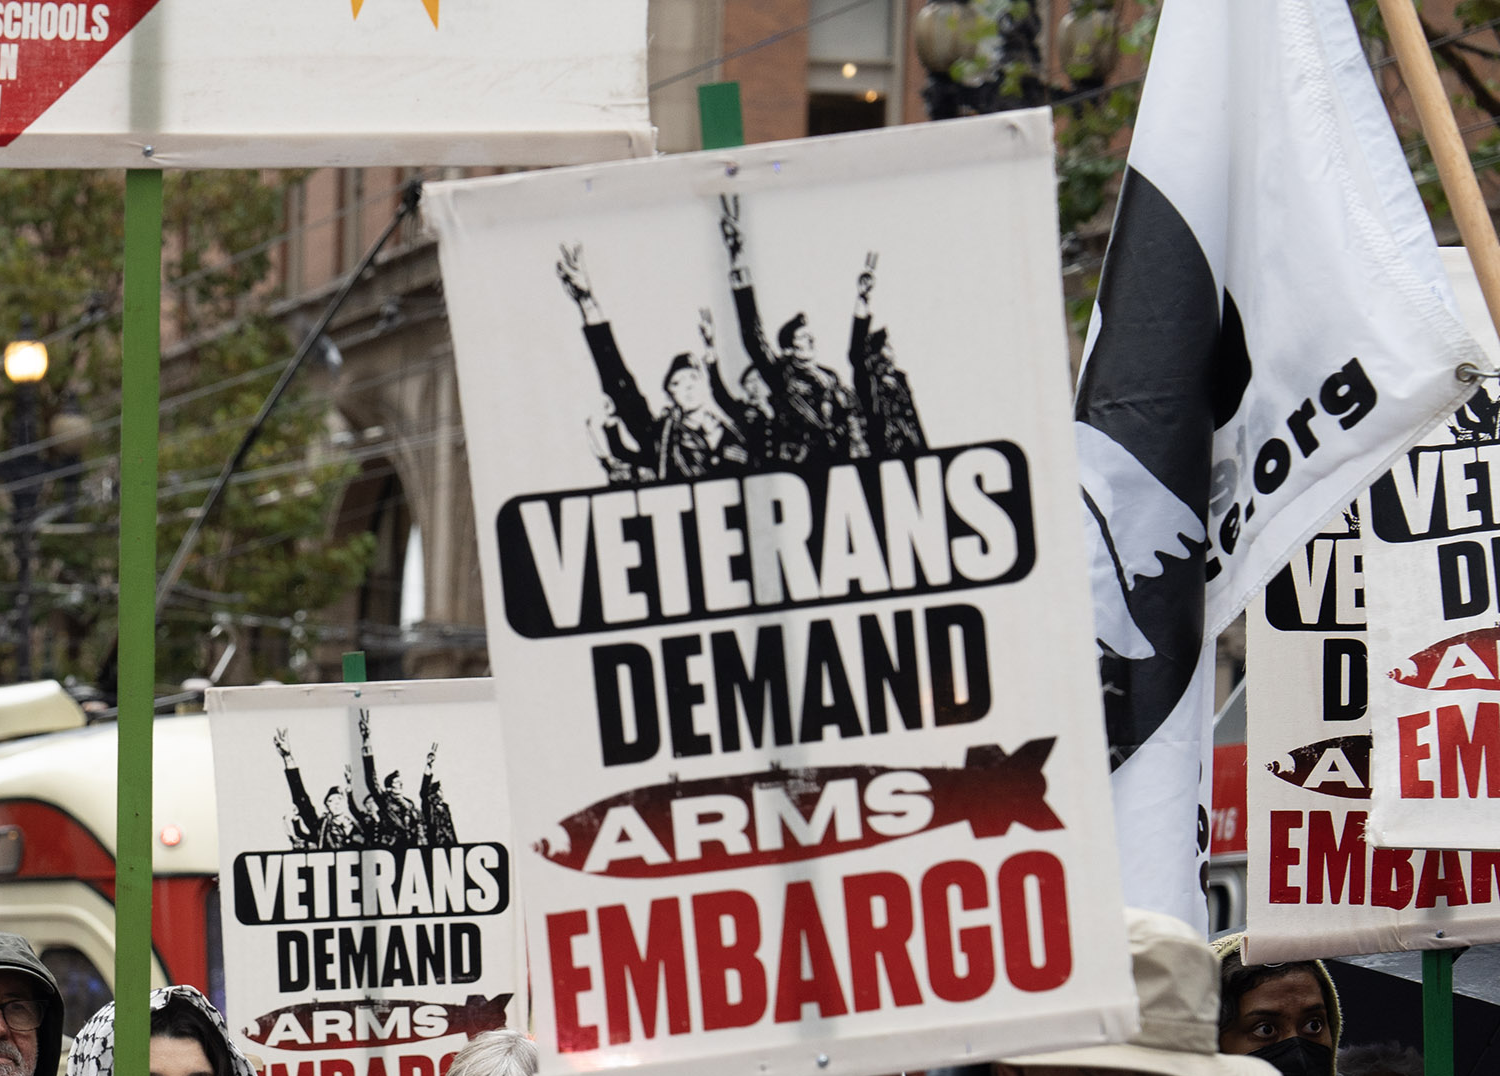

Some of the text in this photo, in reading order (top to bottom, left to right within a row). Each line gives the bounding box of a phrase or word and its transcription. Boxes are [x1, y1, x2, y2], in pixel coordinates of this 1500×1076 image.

[518, 447, 1018, 630] VETERANS
[591, 603, 993, 768] DEMAND
[581, 770, 936, 873] ARMS
[1269, 811, 1500, 910] EMBA
[244, 844, 501, 922] VETERANS
[276, 922, 483, 993] DEMAND
[544, 849, 1074, 1055] EMBARGO
[264, 1003, 451, 1048] ARMS
